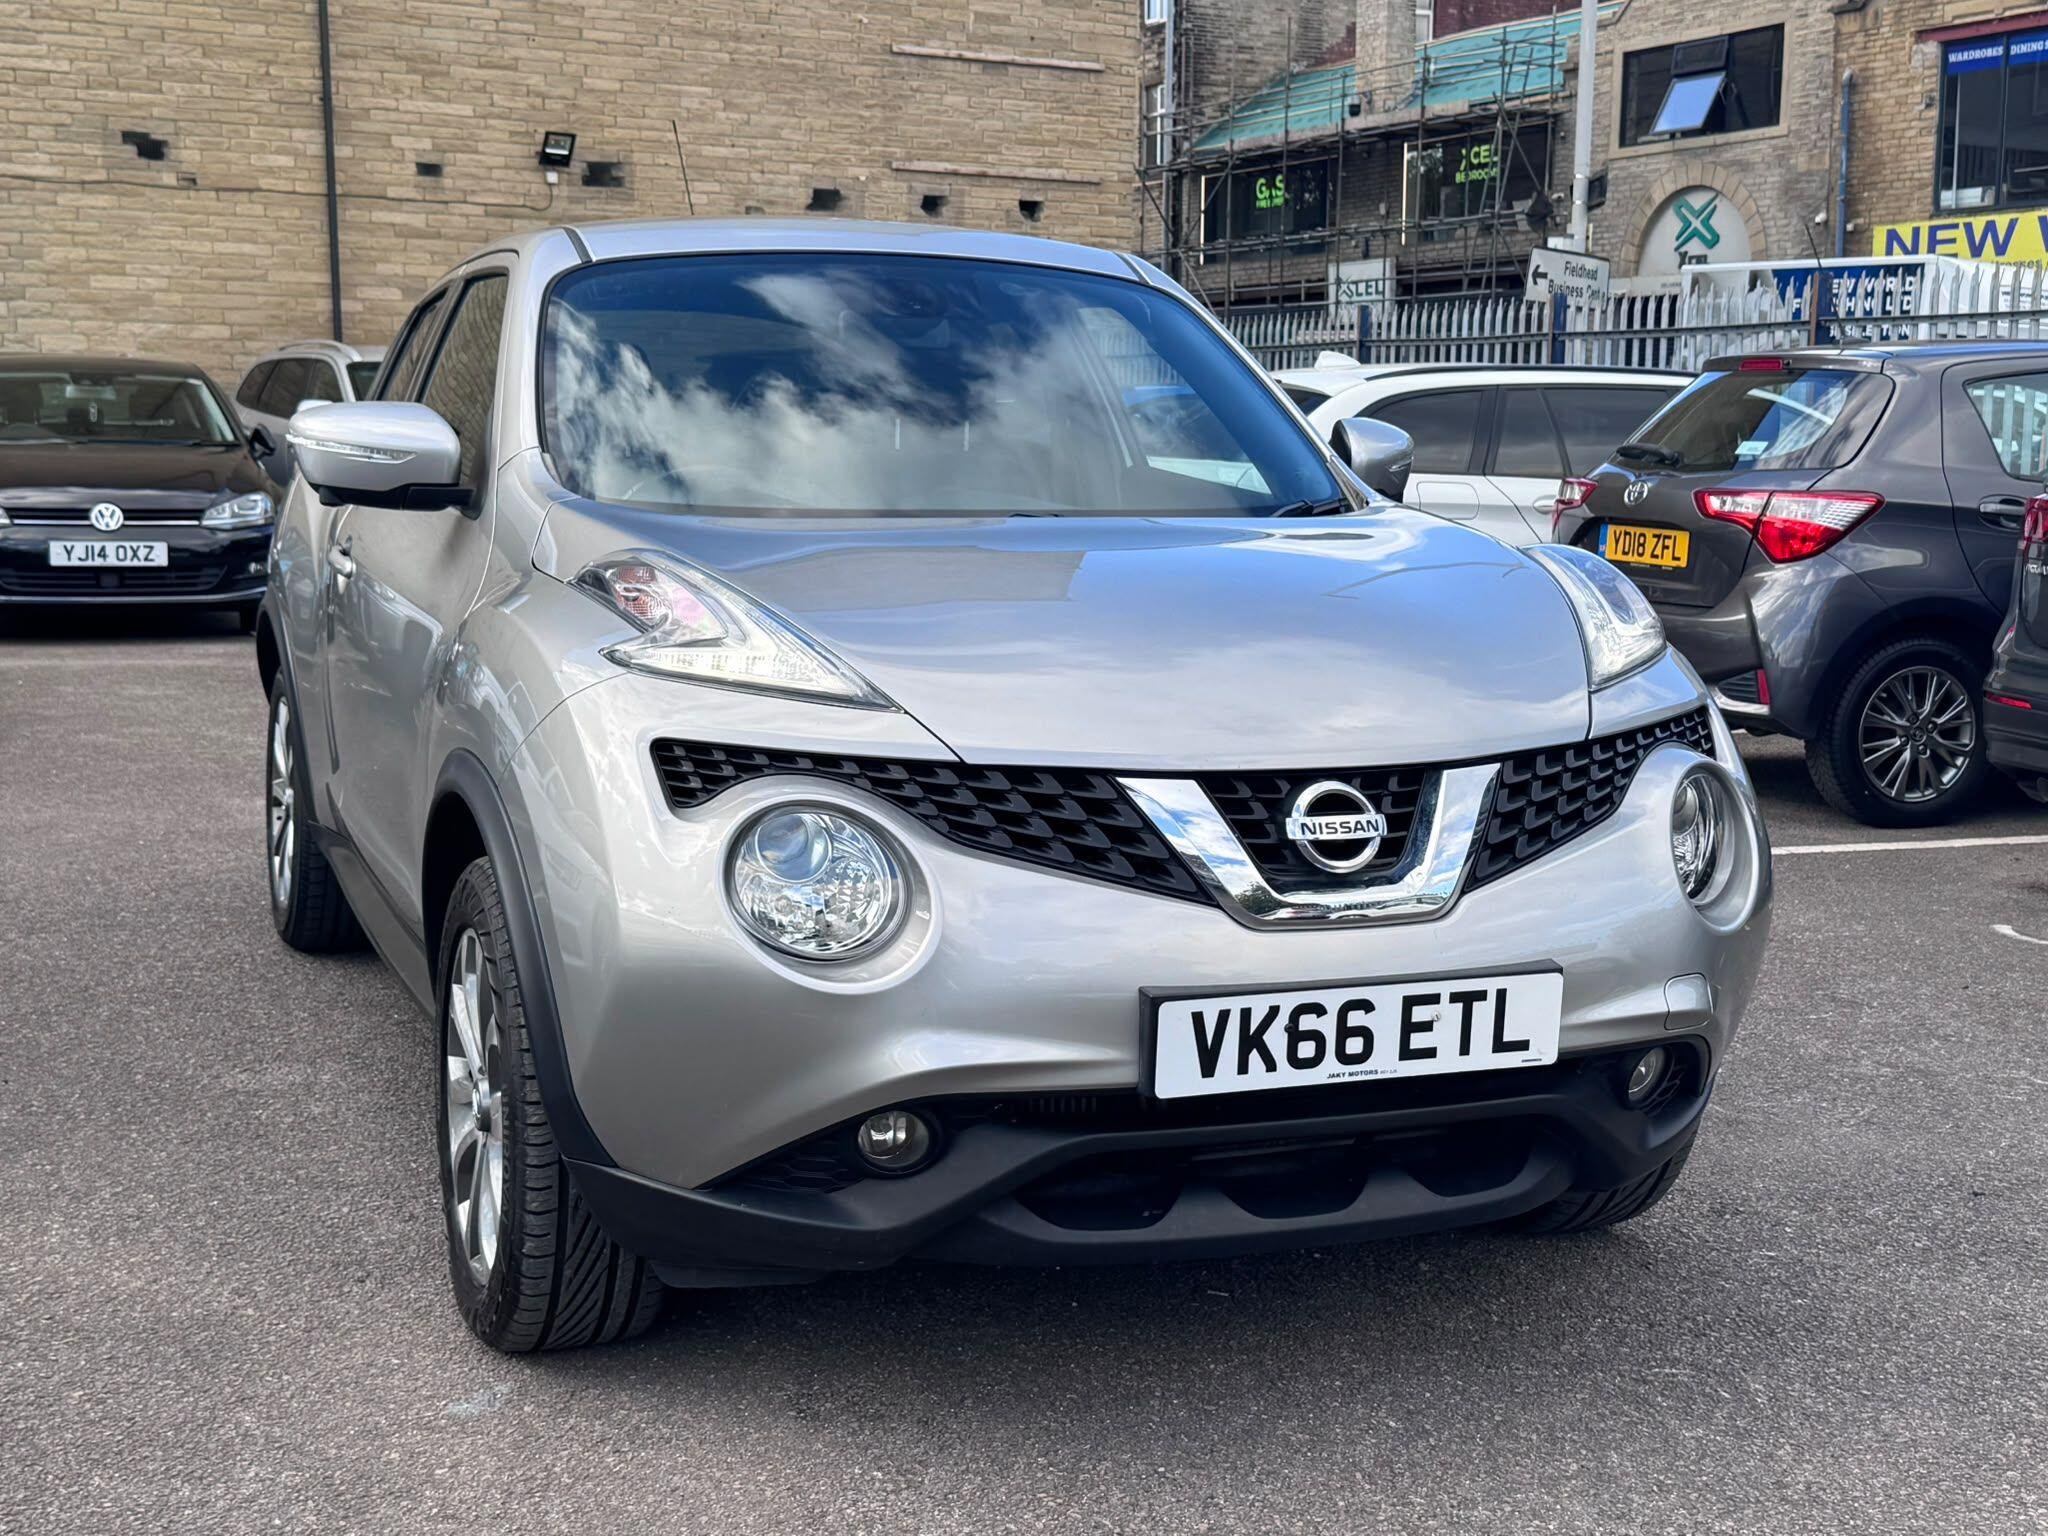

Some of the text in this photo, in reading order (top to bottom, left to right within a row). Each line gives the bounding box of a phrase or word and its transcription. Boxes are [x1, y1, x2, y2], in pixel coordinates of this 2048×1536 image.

[1948, 46, 2004, 63] WARDROBES
[2010, 40, 2044, 56] DINING
[1455, 168, 1499, 183] BEROOM
[1885, 218, 2019, 258] NEW
[1564, 261, 1599, 281] Fieldhead
[1547, 278, 1606, 300] Business Cente
[1862, 276, 1916, 293] WRD
[1885, 295, 1913, 312] LD
[63, 544, 156, 562] YJ14 OXZ
[1613, 529, 1682, 562] YD18 ZFL
[1300, 818, 1380, 836] NISSAN
[1191, 988, 1532, 1079] VK66 ETL
[1348, 1069, 1379, 1077] MOTORS
